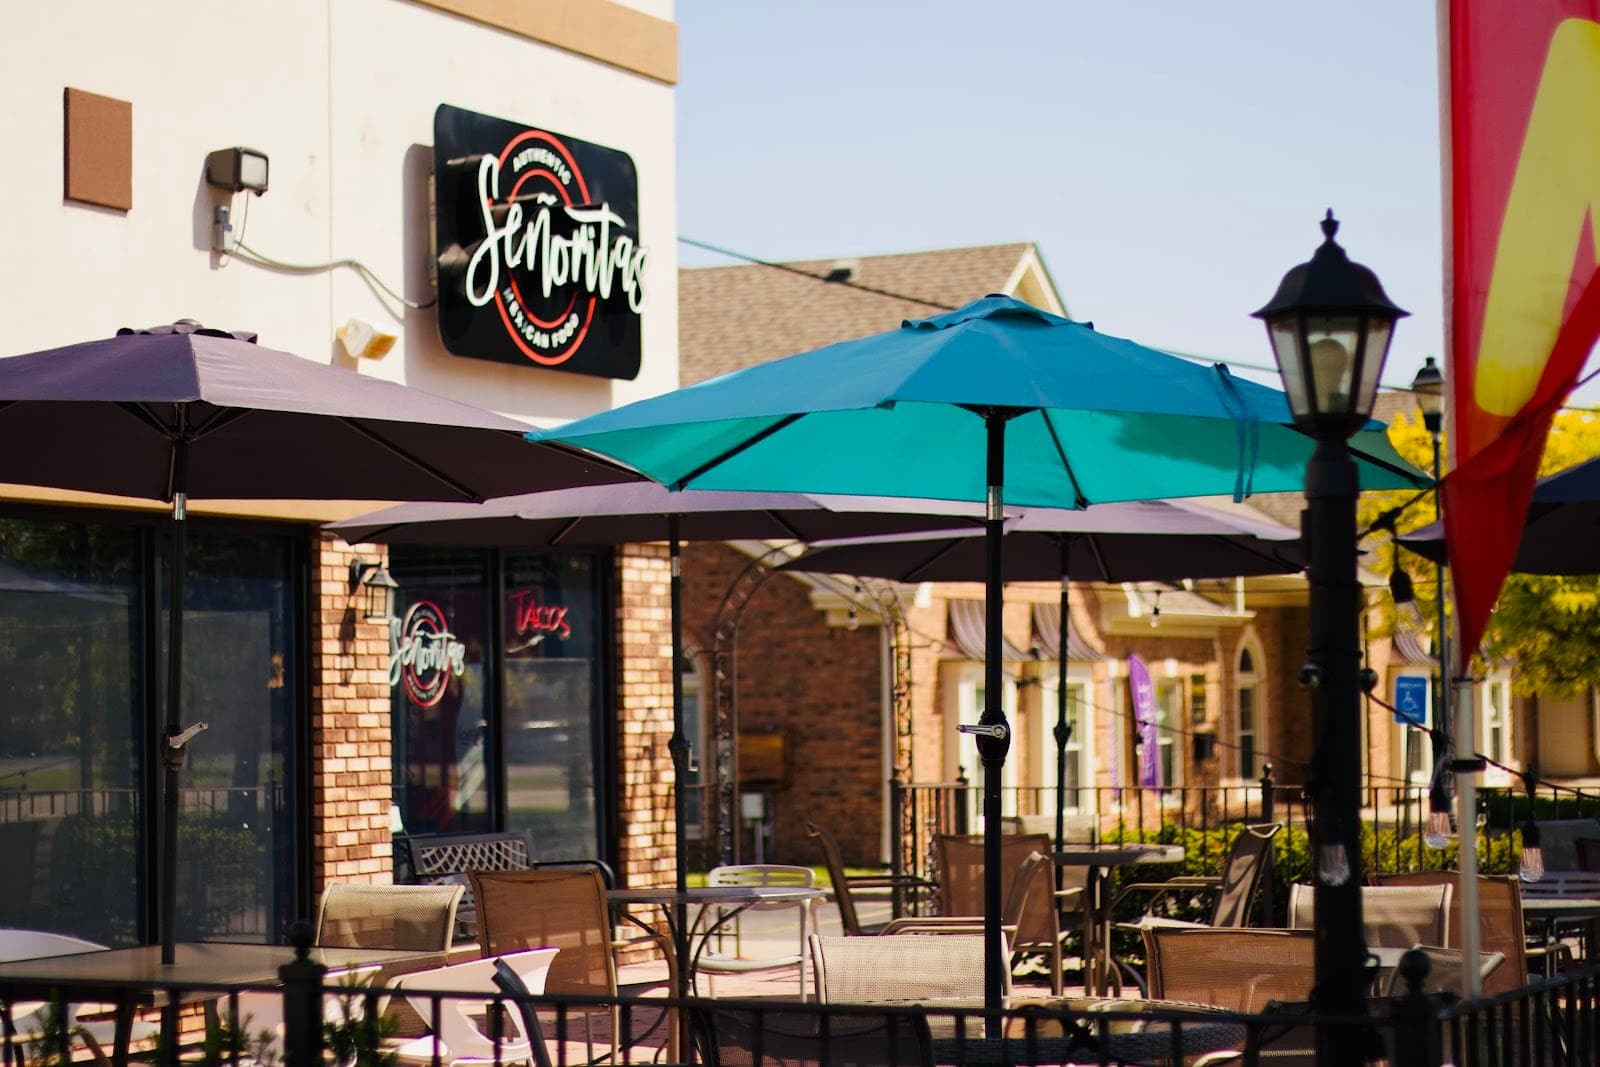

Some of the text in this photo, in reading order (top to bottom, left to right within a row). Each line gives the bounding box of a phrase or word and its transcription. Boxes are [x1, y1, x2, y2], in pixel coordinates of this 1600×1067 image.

[512, 147, 572, 186] AUTHENTIC
[465, 152, 650, 315] Señoritas
[503, 287, 580, 349] MEXICAN FOOD
